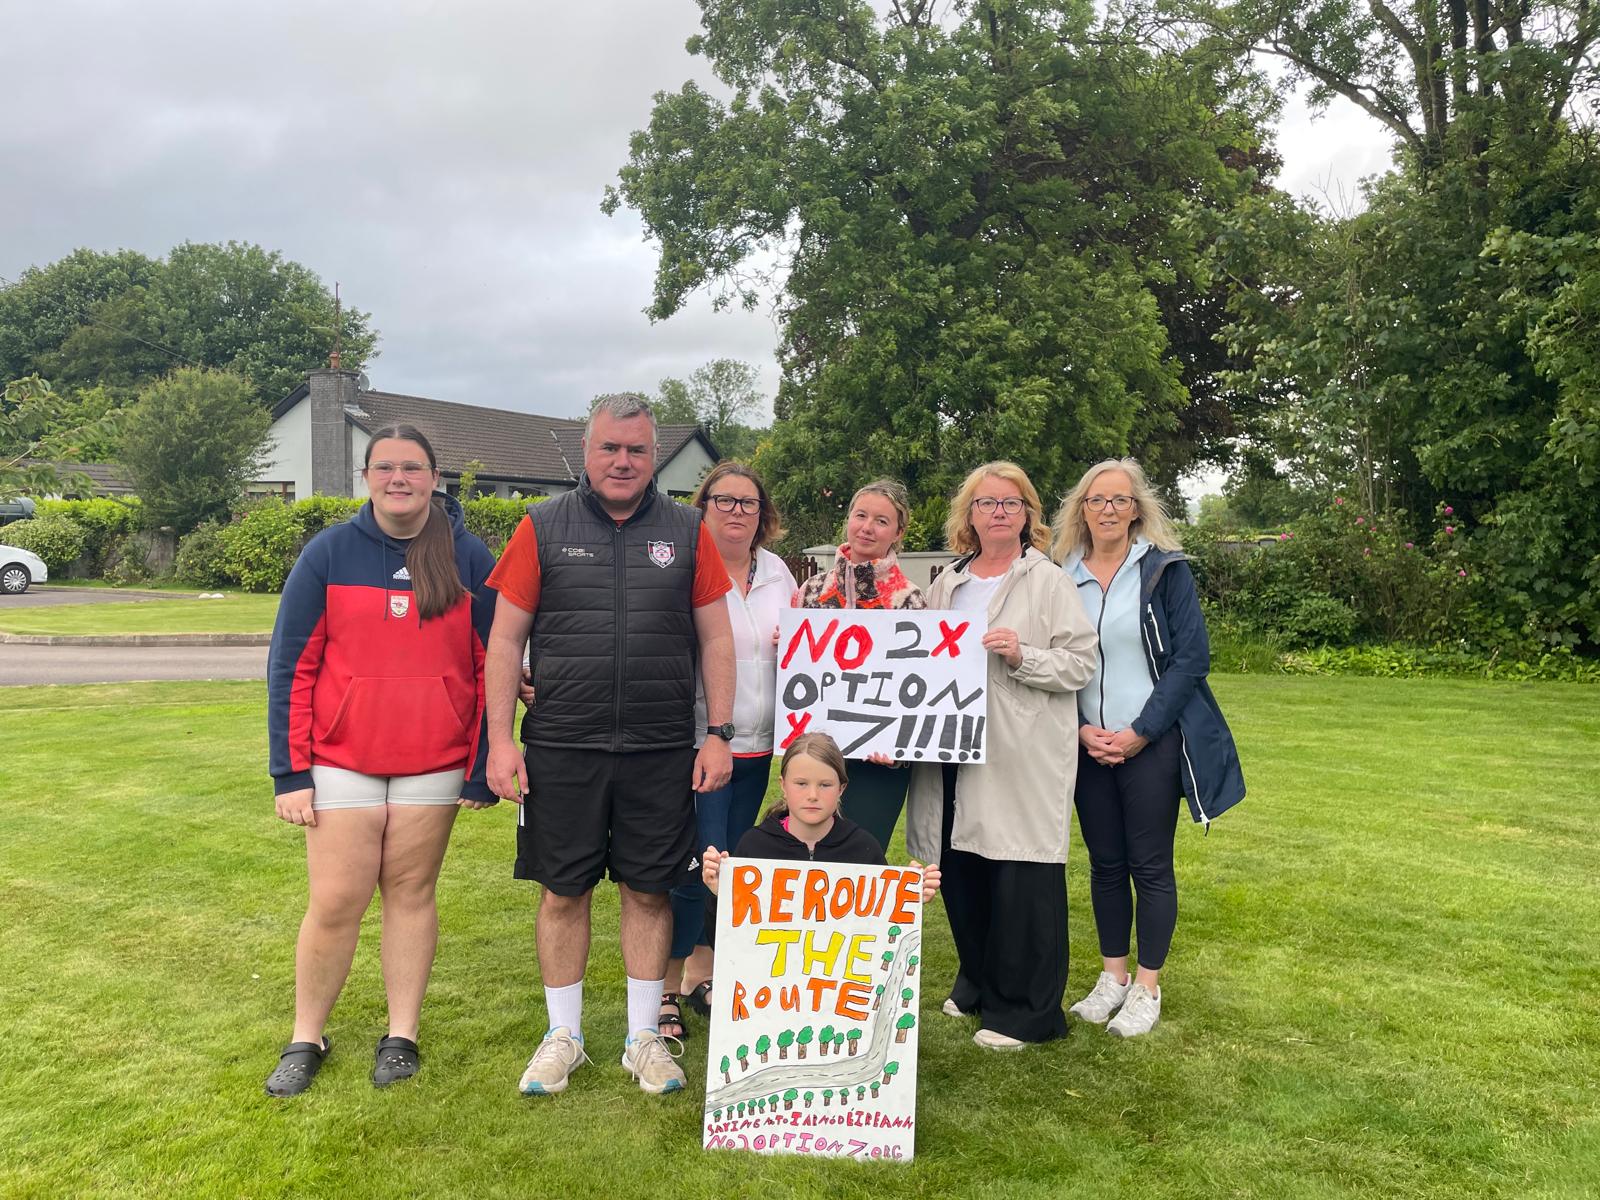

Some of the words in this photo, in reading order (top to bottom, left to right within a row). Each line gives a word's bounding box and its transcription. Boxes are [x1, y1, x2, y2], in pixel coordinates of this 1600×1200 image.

[780, 618, 874, 670] NO
[782, 671, 984, 710] OPTION
[732, 865, 921, 927] REROUTE
[755, 929, 877, 984] THE
[732, 978, 874, 1021] ROUTE
[707, 1119, 761, 1136] SAYING
